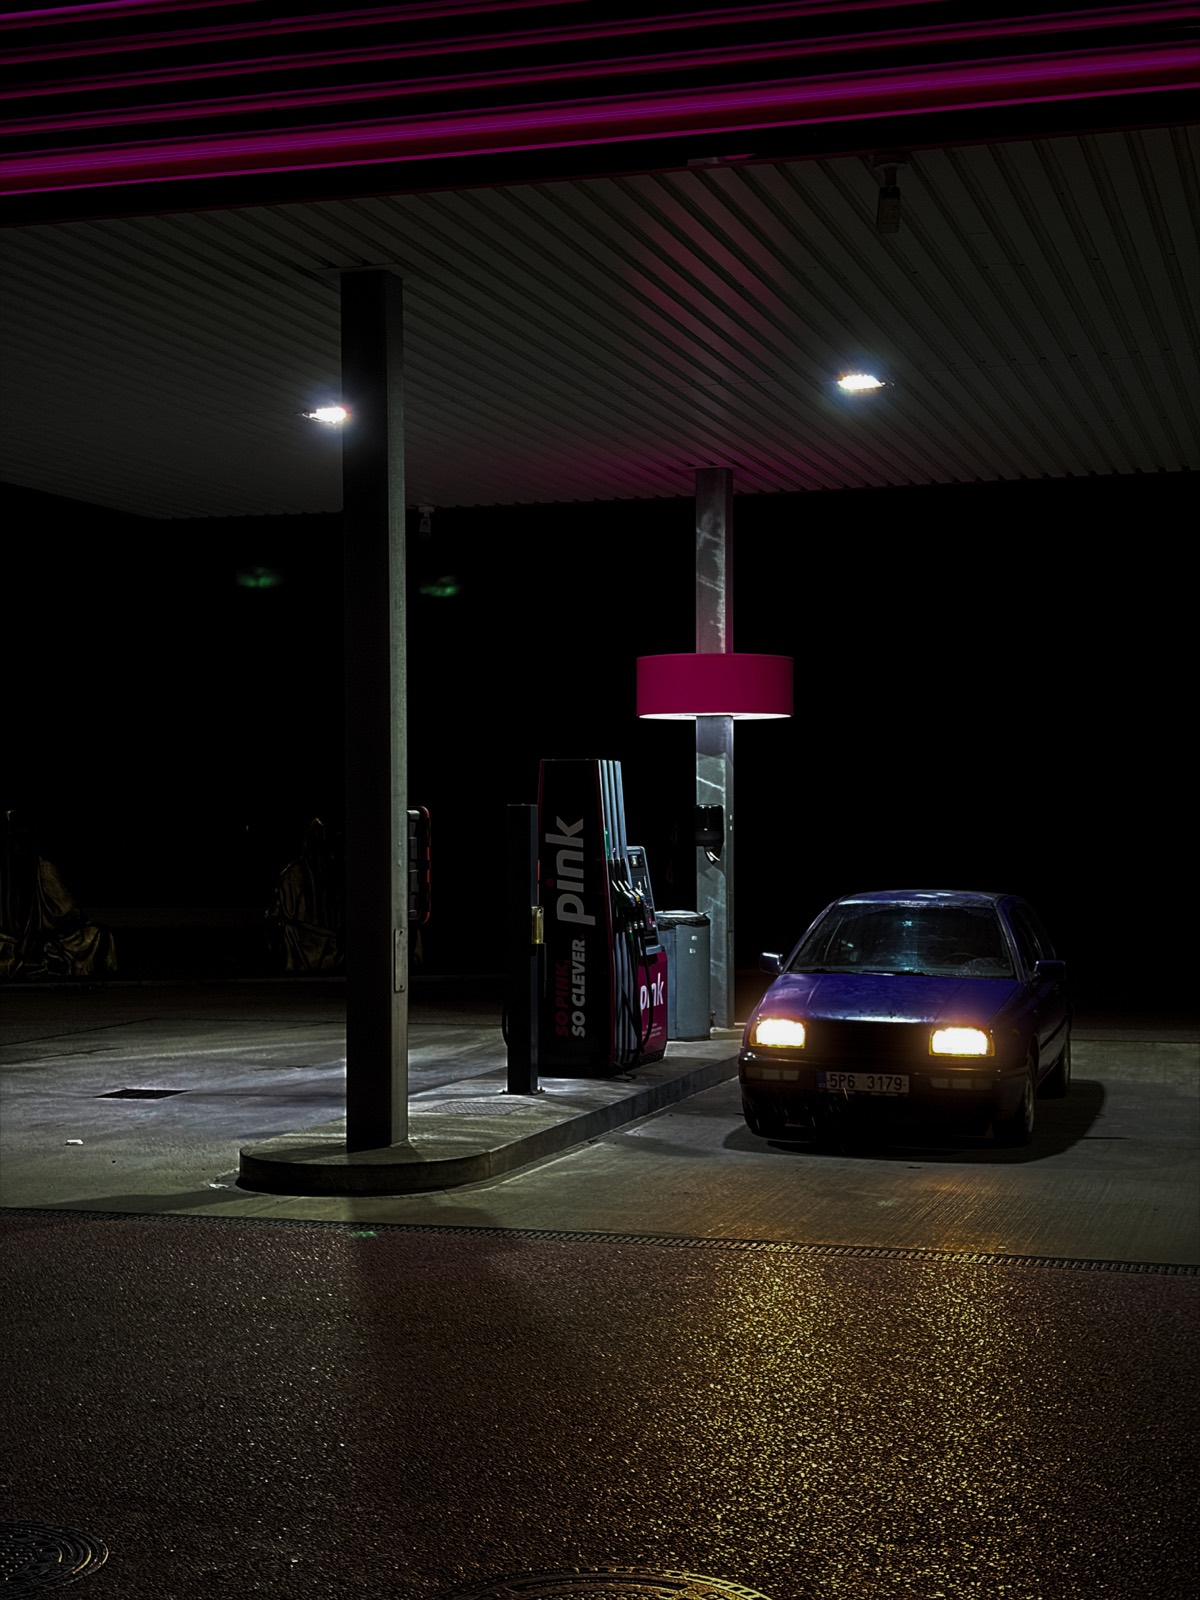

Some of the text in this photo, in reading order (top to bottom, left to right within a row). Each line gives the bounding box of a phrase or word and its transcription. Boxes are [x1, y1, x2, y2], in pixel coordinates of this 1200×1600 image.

[545, 816, 596, 926] pink
[554, 1010, 570, 1037] SO
[571, 1011, 586, 1037] SO
[829, 1074, 902, 1091] 5P6 3179
